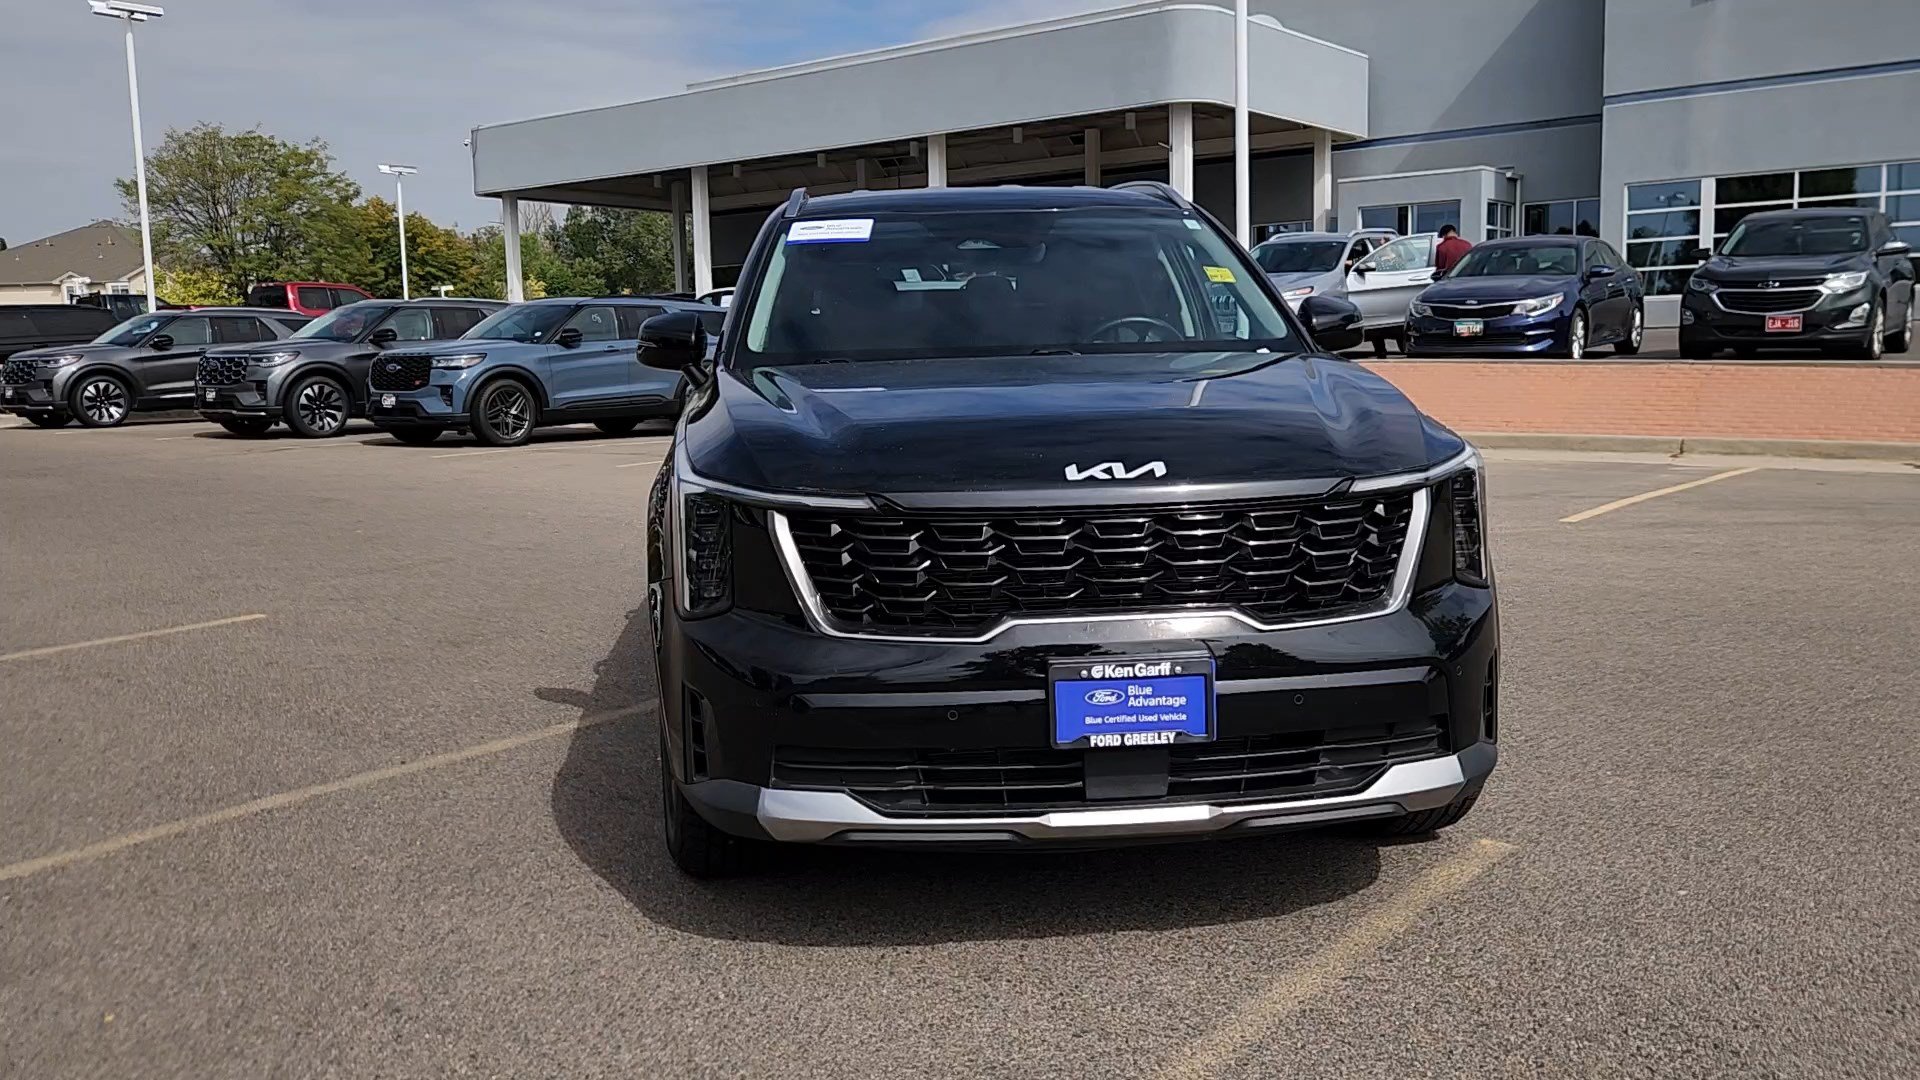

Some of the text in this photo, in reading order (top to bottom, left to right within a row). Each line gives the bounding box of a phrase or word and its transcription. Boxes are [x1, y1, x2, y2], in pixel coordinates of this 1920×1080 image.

[1064, 461, 1167, 481] KIA
[1105, 664, 1134, 678] Ken
[1135, 662, 1171, 677] Garff
[1127, 685, 1152, 695] Blue
[1092, 691, 1117, 703] Ford
[1127, 695, 1187, 707] Advantage
[1085, 713, 1187, 724] Blue Certified Used Vehicle
[1090, 732, 1176, 747] FORD GREELEY
